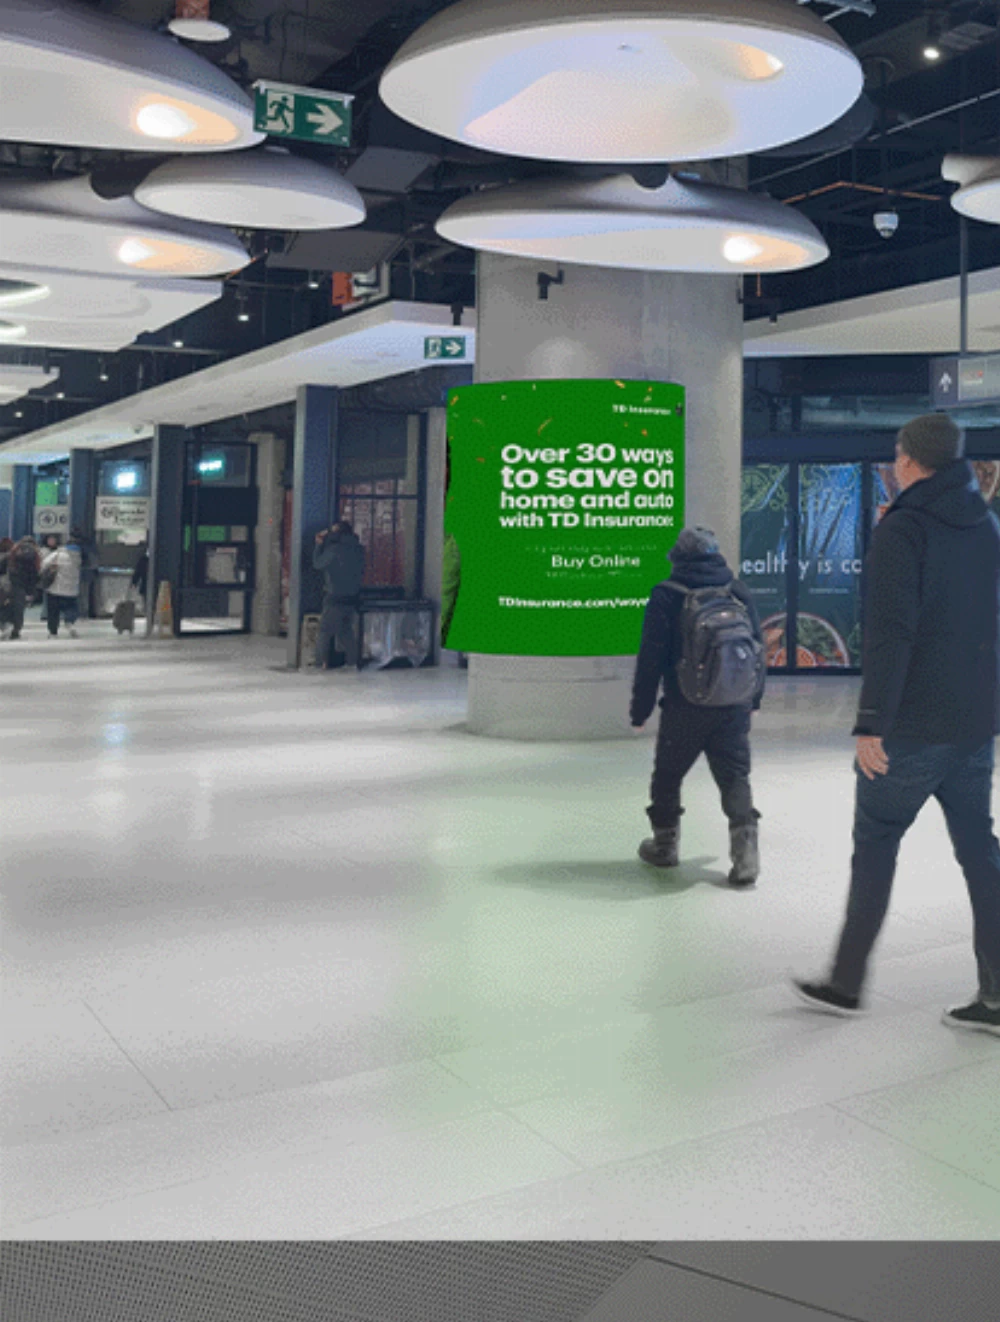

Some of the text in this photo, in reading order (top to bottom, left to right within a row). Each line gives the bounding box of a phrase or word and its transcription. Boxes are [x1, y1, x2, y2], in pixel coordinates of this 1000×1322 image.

[501, 443, 674, 467] Over 30 ways
[501, 466, 674, 489] to save on
[501, 491, 674, 509] home and auto
[500, 512, 543, 527] with
[548, 512, 579, 527] TD
[552, 554, 641, 569] Buy Online
